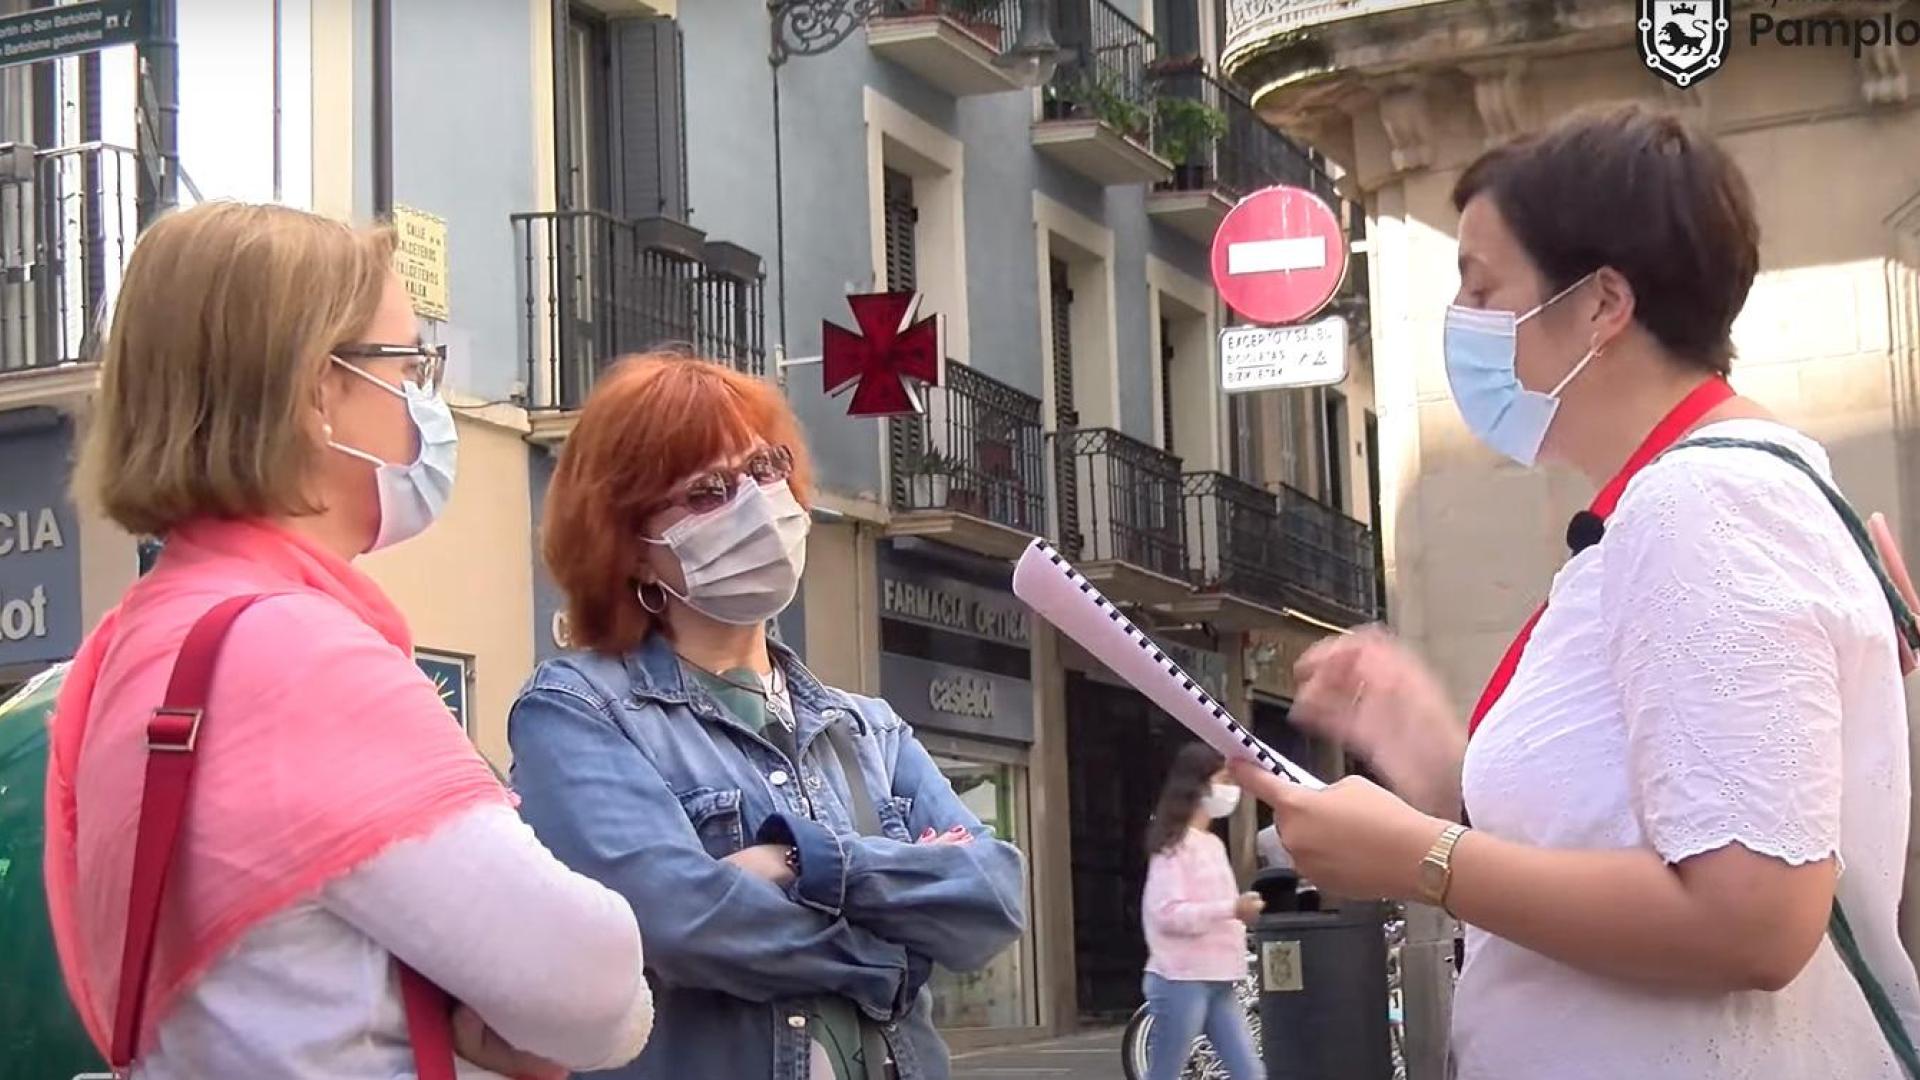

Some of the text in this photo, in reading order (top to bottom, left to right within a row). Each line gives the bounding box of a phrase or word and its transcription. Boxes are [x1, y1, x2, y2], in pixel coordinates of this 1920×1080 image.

[33, 18, 52, 32] San
[884, 578, 1029, 640] FARMACIA OPTICA
